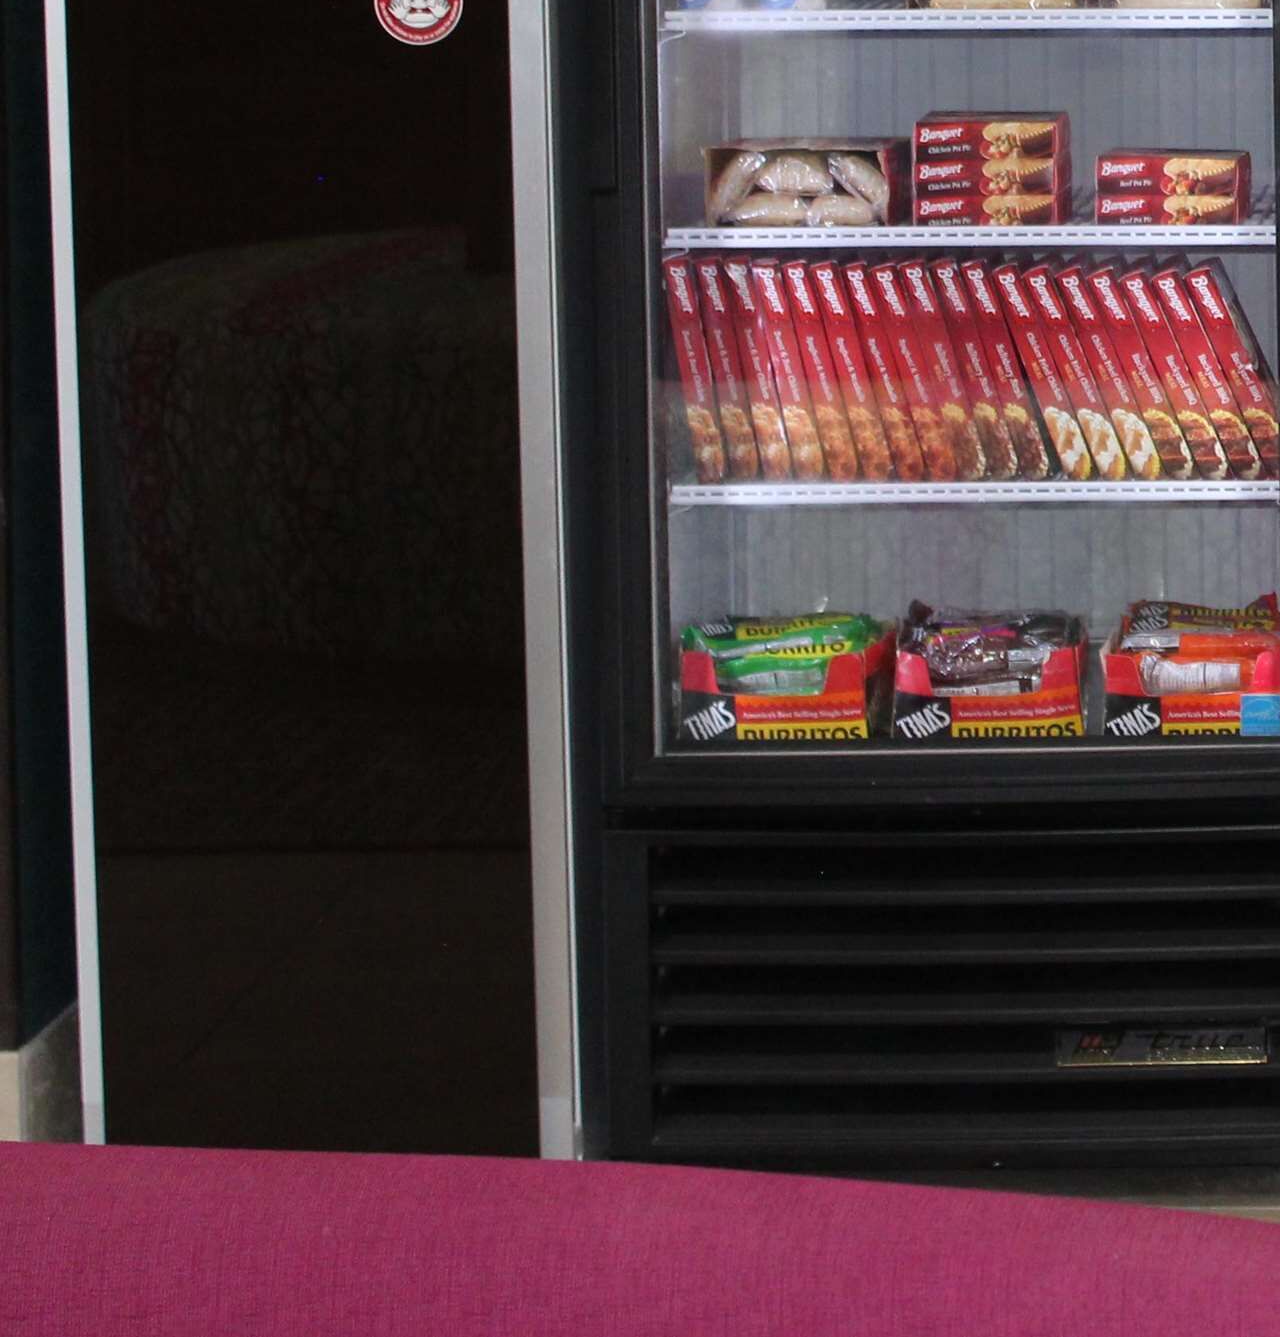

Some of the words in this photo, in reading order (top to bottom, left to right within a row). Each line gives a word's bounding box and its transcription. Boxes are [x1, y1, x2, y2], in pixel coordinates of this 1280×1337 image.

[920, 128, 963, 142] Banquet
[928, 146, 951, 154] Chicken
[920, 164, 963, 179] Banquet
[1101, 162, 1145, 176] Banquet
[920, 200, 964, 215] Banquet
[1101, 199, 1145, 213] Banquet
[999, 273, 1030, 318] Banquet
[1029, 275, 1062, 320] Banquet
[1063, 275, 1094, 321] Banquet
[1094, 275, 1126, 321] Banquet
[1125, 279, 1159, 324] Banquet
[1158, 277, 1192, 322] Banquet
[1191, 275, 1225, 320] Banquet
